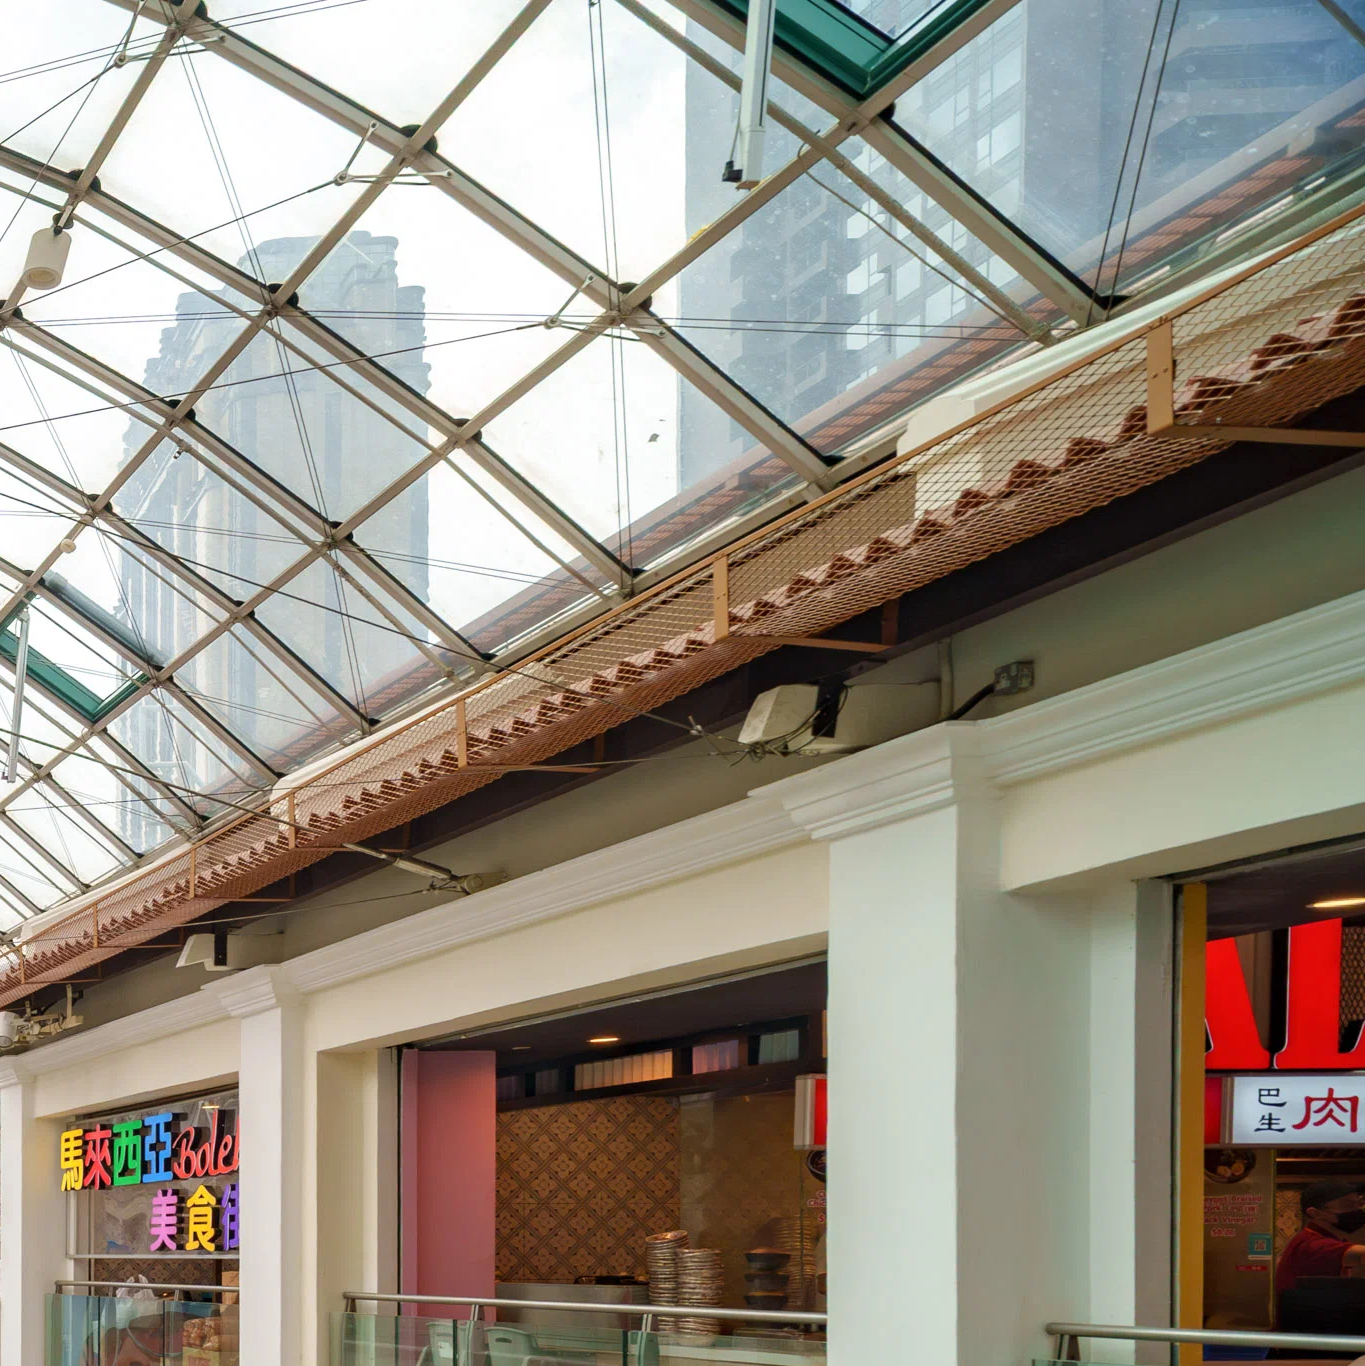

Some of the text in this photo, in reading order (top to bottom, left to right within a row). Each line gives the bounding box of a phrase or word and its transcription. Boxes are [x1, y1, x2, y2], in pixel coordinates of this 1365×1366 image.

[1291, 1087, 1359, 1134] 肉
[60, 1112, 174, 1192] 馬來西亞
